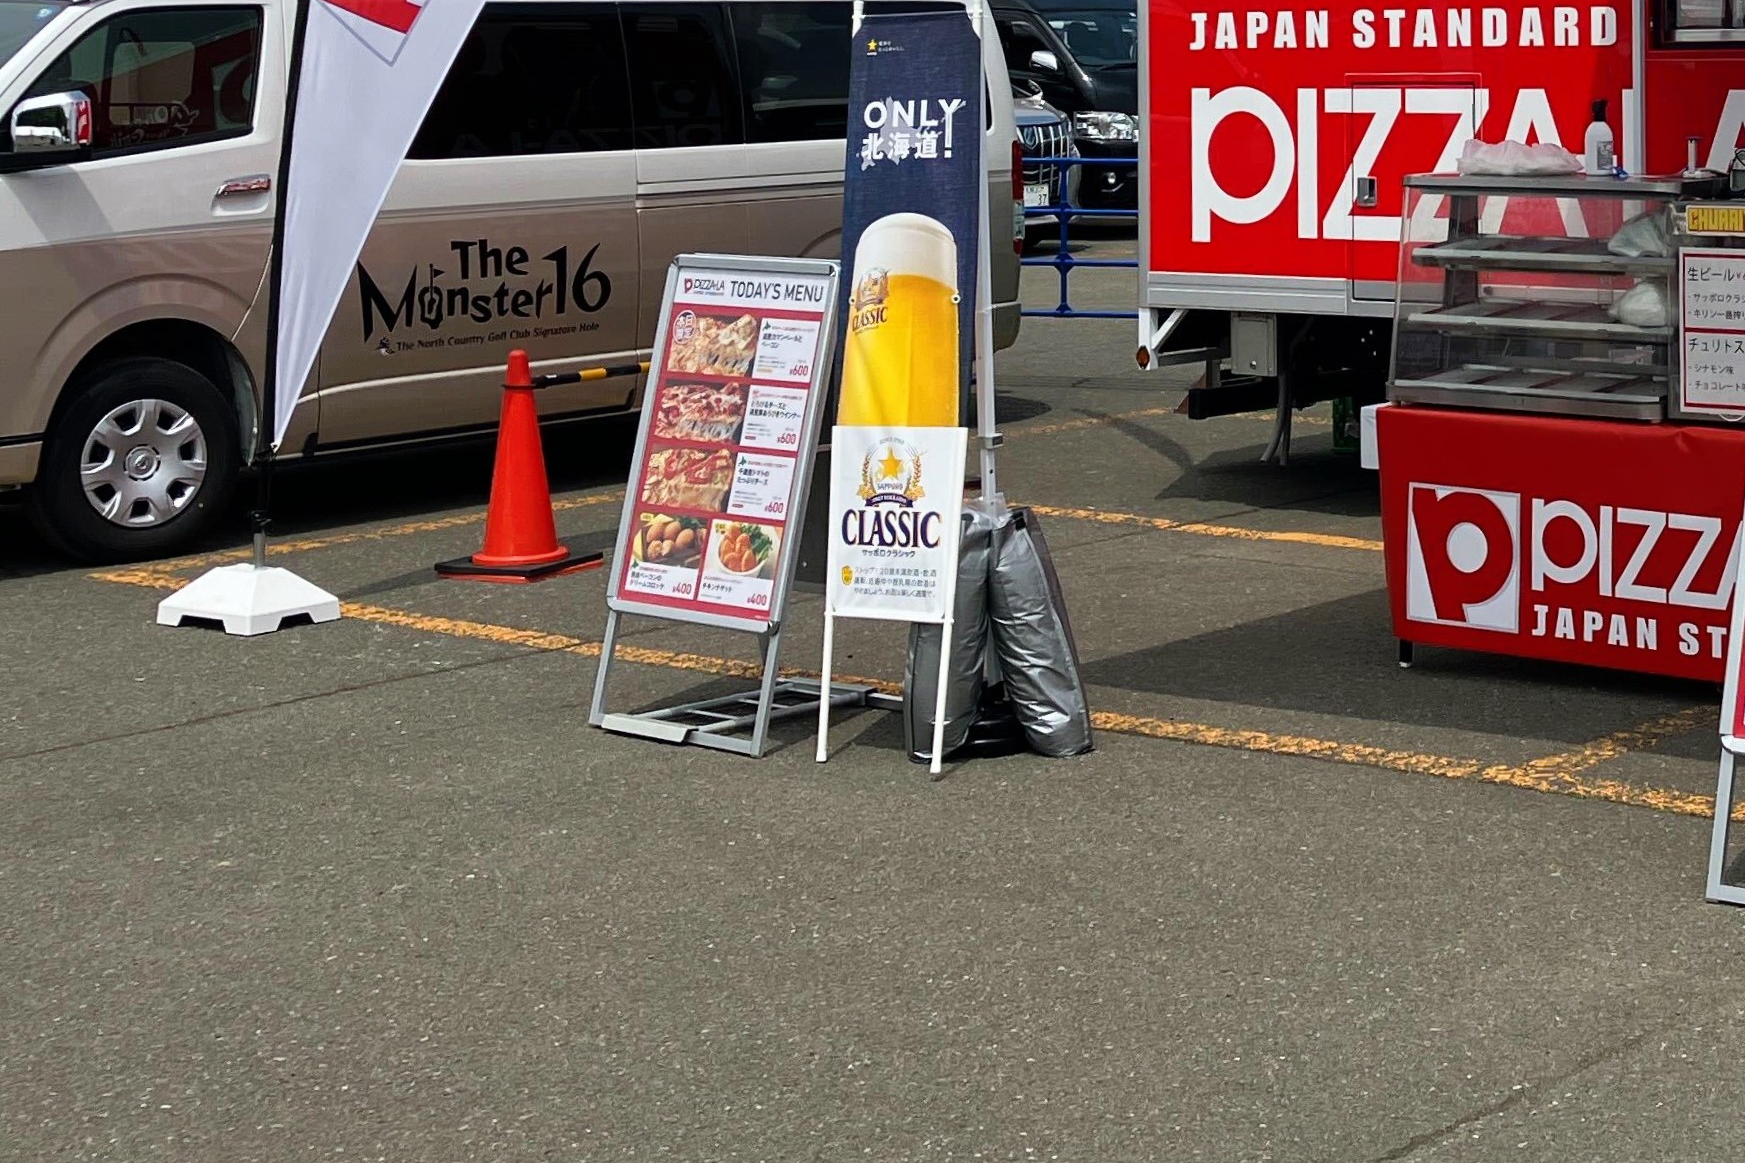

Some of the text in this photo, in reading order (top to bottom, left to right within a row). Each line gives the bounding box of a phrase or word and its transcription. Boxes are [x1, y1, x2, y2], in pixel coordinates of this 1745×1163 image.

[1190, 6, 1618, 51] JAPAN STANDARD
[863, 98, 962, 130] ONLY
[450, 238, 530, 281] The
[1687, 266, 1735, 283] 生ビール
[541, 241, 612, 315] 16
[730, 280, 781, 300] TODAY'S
[783, 284, 824, 303] MENU
[396, 322, 600, 352] The North Country Golf Club Signature Hole
[1688, 337, 1745, 355] チュリトス
[841, 508, 942, 549] CLASSIC
[861, 549, 917, 559] サッポロクラシック
[1532, 604, 1658, 651] JAPAN
